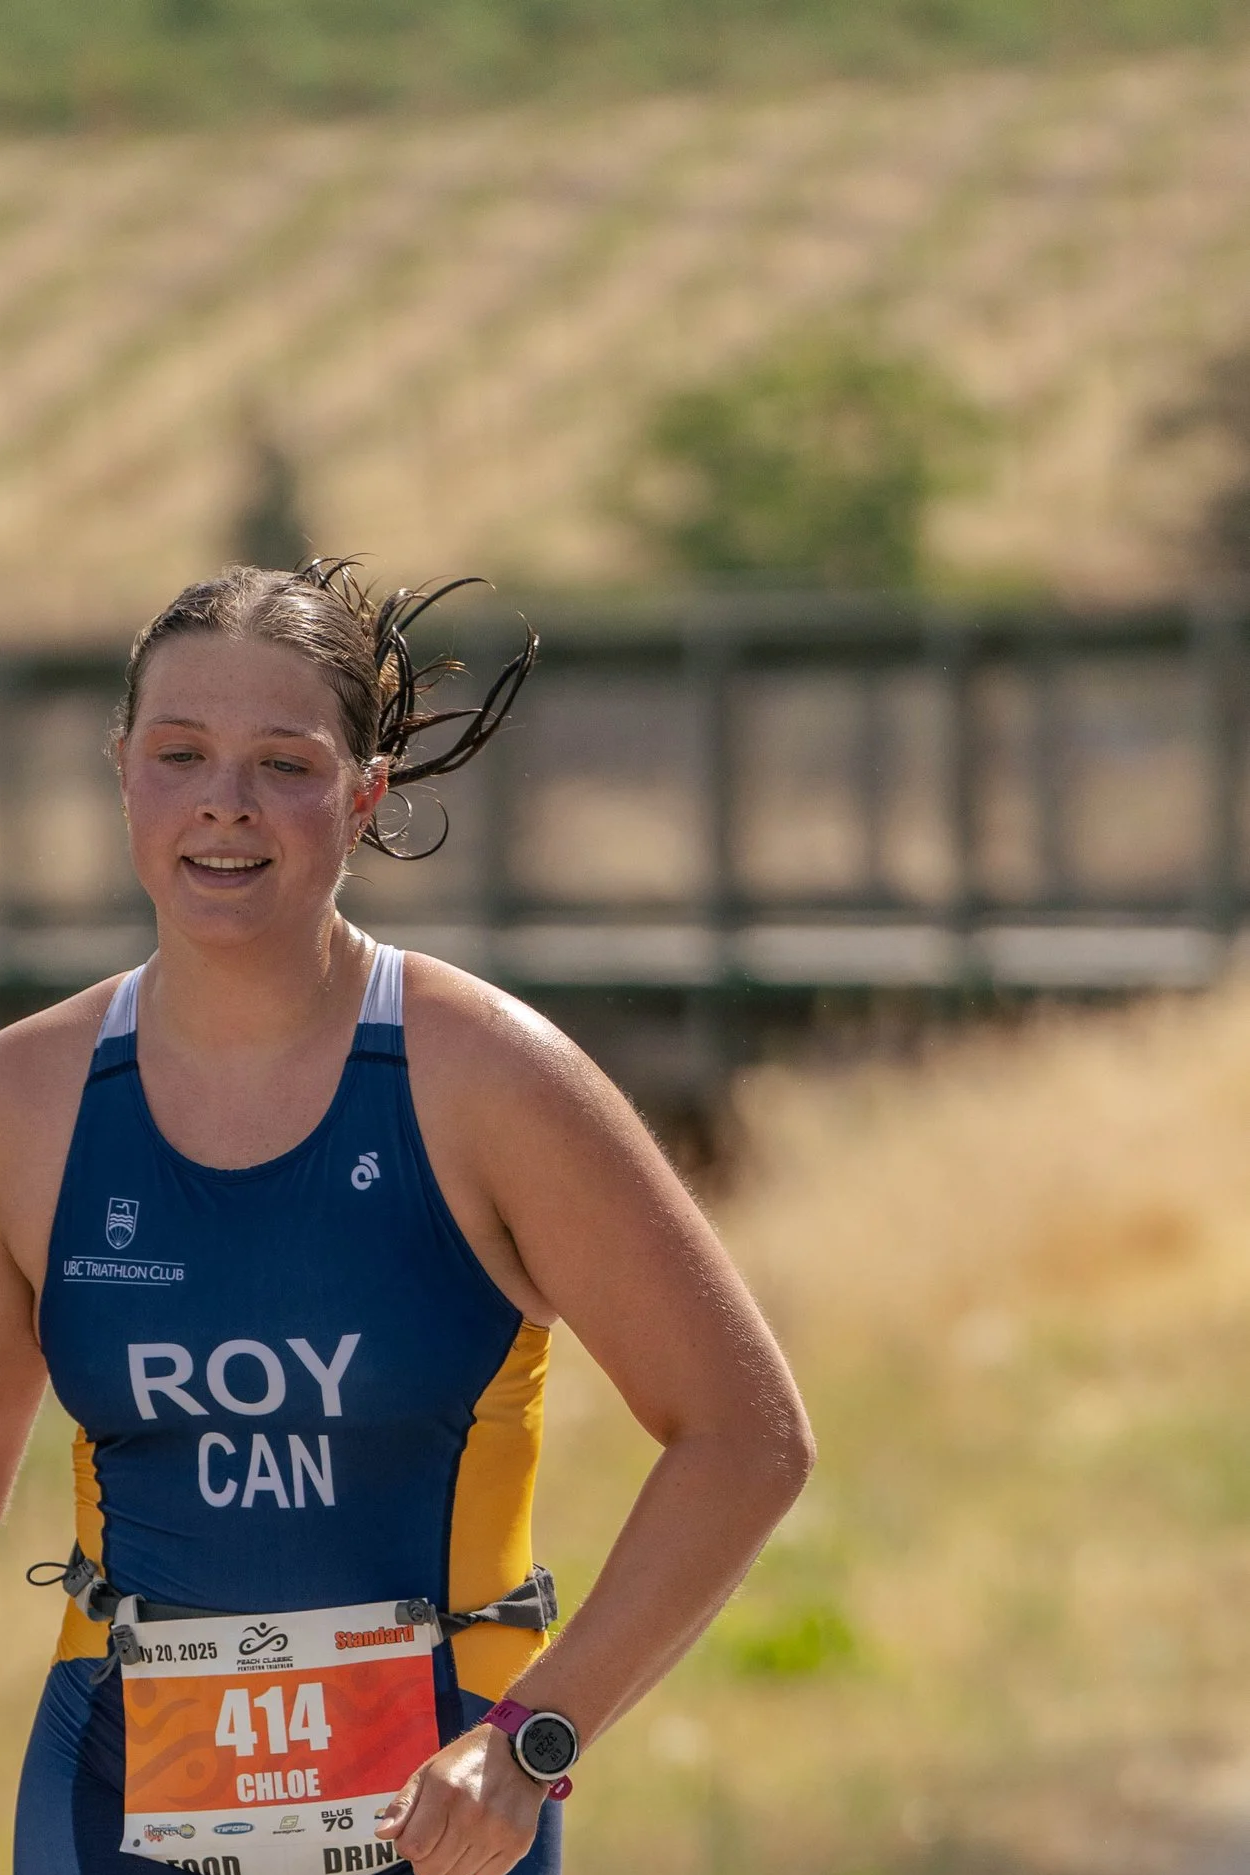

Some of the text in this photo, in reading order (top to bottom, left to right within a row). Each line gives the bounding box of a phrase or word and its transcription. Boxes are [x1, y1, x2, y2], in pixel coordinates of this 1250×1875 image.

[63, 1260, 85, 1276] UBC
[149, 1265, 185, 1281] CLUB
[127, 1333, 362, 1421] ROY
[197, 1431, 337, 1509] CAN
[334, 1625, 415, 1651] Standard
[155, 1644, 177, 1663] 20,
[178, 1642, 218, 1661] 2025
[262, 1656, 293, 1664] CLASSIC
[266, 1663, 294, 1671] TRIATHLON
[214, 1682, 333, 1757] 414
[236, 1768, 322, 1803] CHLOE
[321, 1808, 353, 1818] BLUE
[322, 1816, 354, 1832] 70
